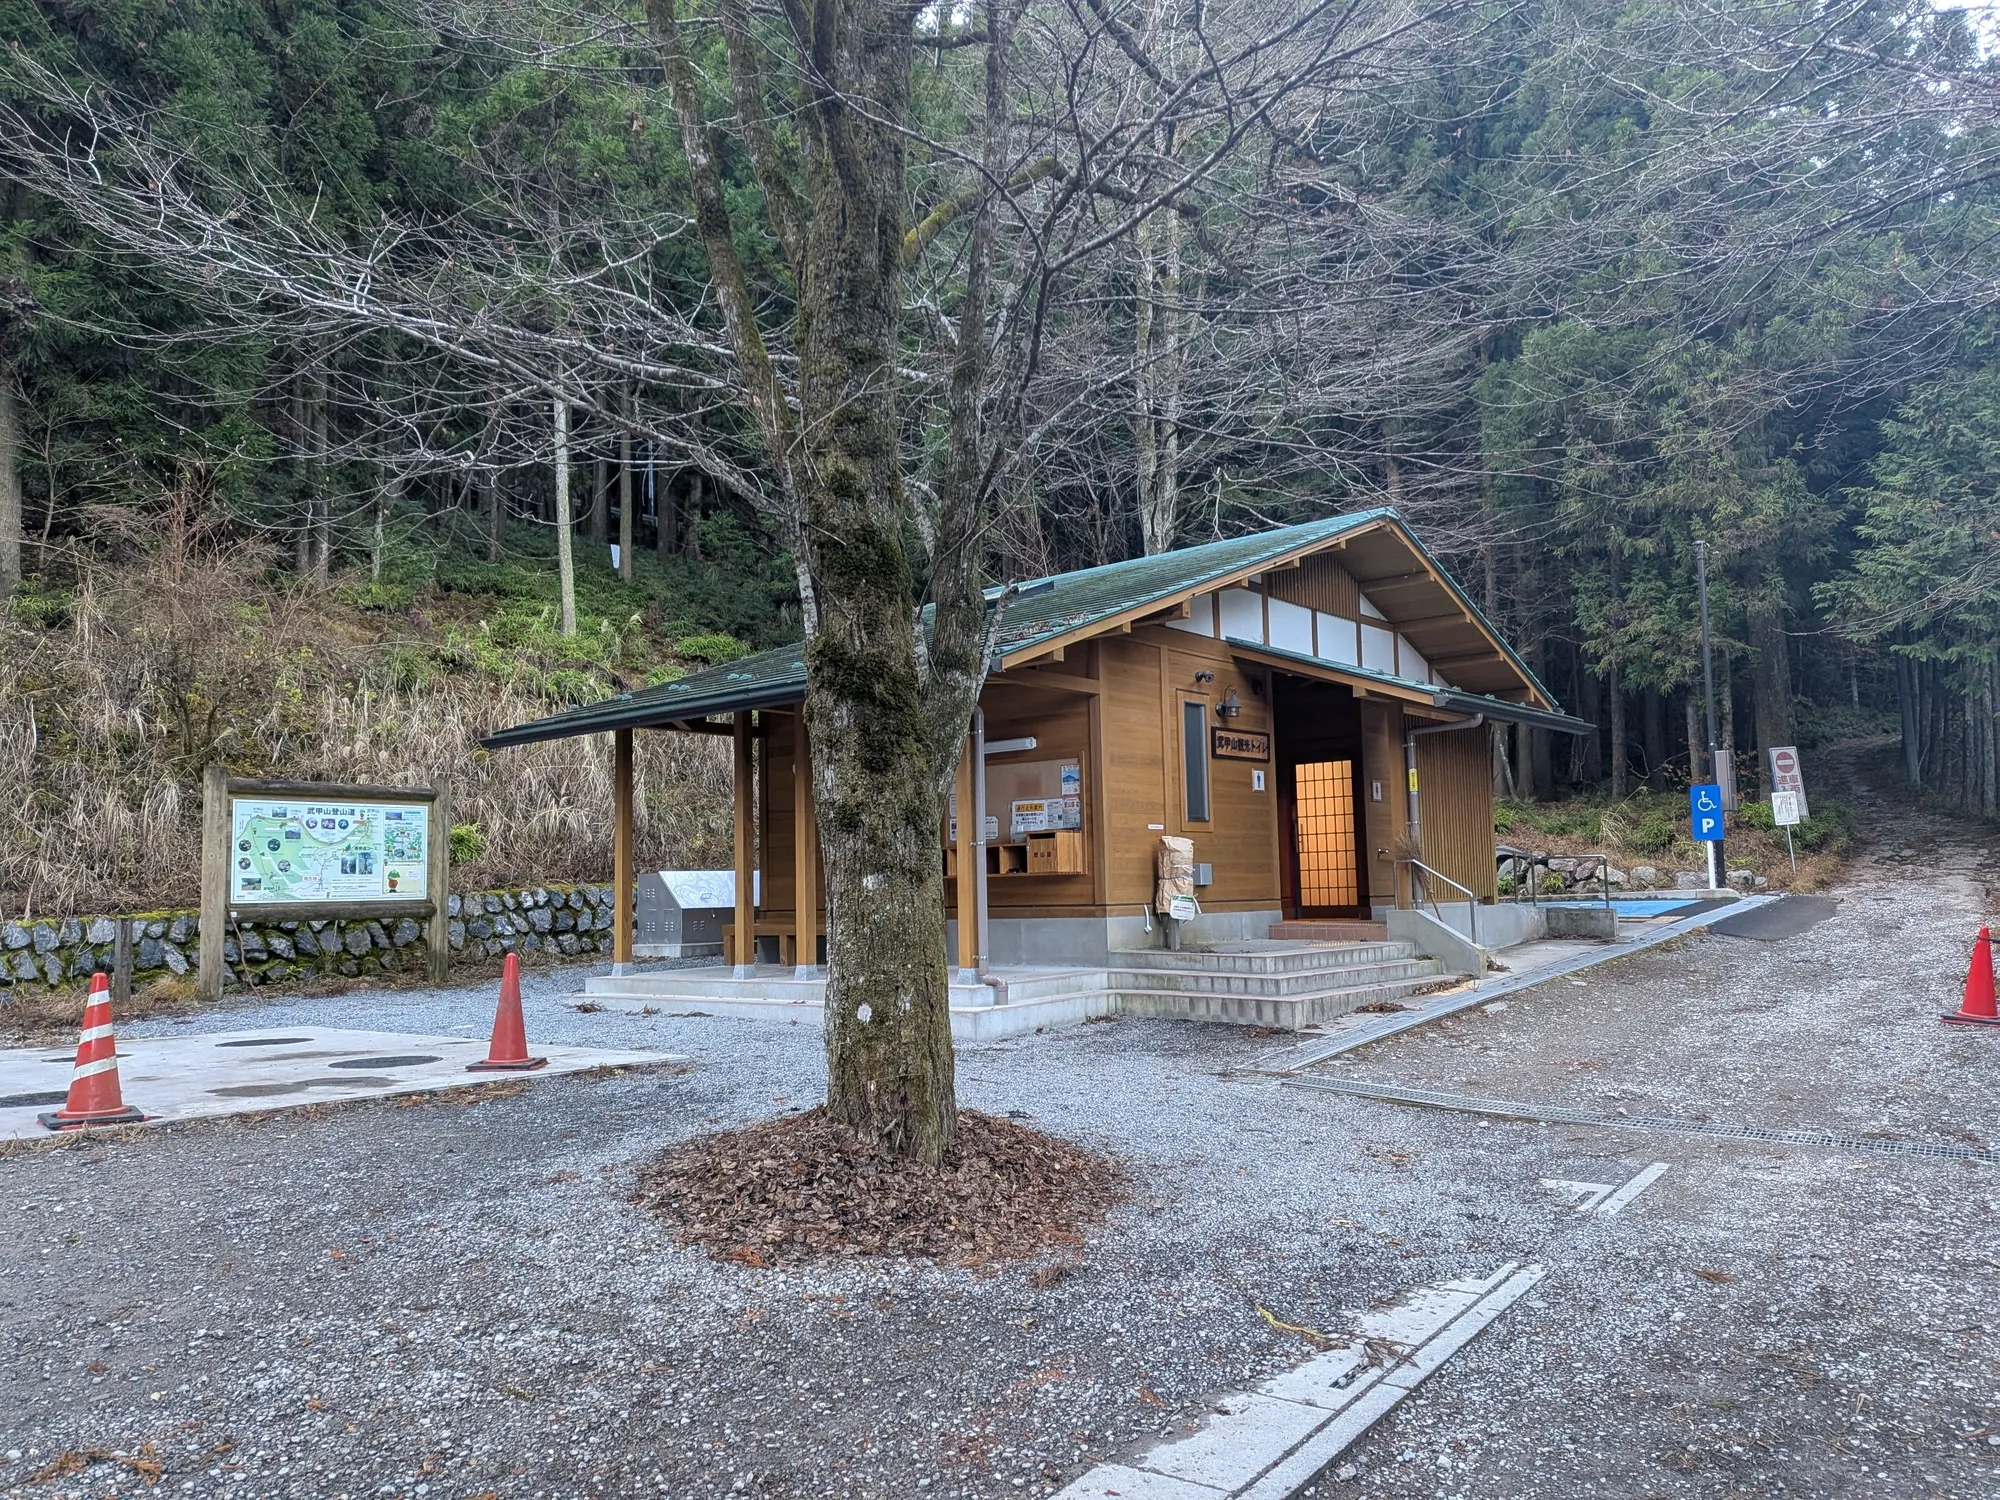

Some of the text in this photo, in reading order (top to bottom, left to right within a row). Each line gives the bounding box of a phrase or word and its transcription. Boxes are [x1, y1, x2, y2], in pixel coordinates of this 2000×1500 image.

[1217, 735, 1269, 754] 武甲山観光トイレ
[1788, 774, 1801, 794] 車両
[307, 807, 356, 816] 武甲山登山道
[1701, 818, 1715, 834] P
